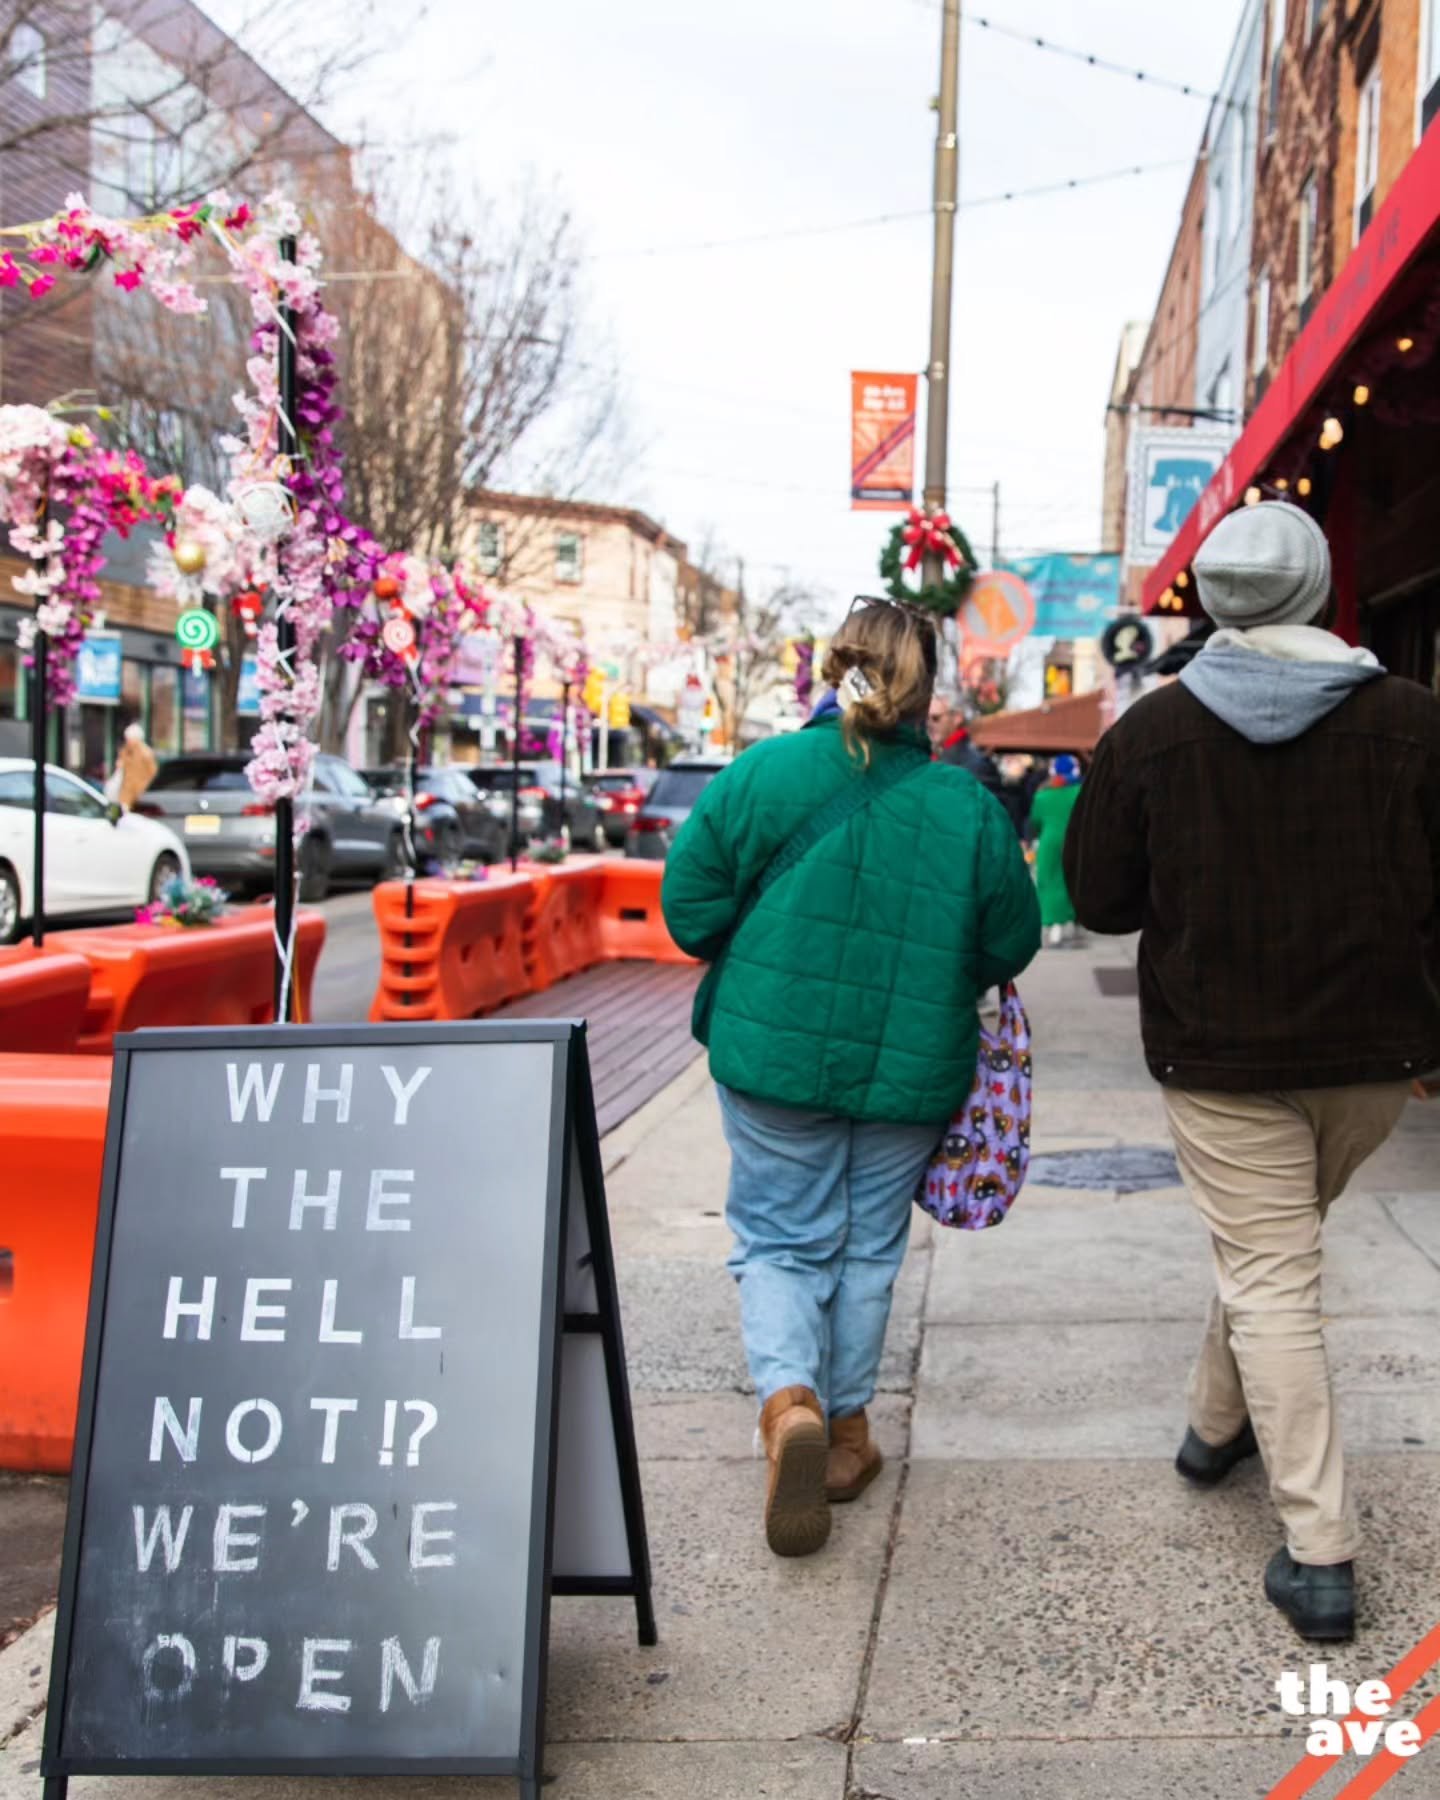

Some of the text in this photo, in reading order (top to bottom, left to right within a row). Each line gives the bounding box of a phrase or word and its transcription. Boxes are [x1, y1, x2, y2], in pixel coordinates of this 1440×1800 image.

[226, 1062, 432, 1124] WHY
[220, 1167, 415, 1231] THE
[163, 1276, 442, 1344] HELL
[148, 1396, 439, 1466] NOT!?
[132, 1499, 458, 1573] WE'RE
[142, 1632, 442, 1713] OPEN
